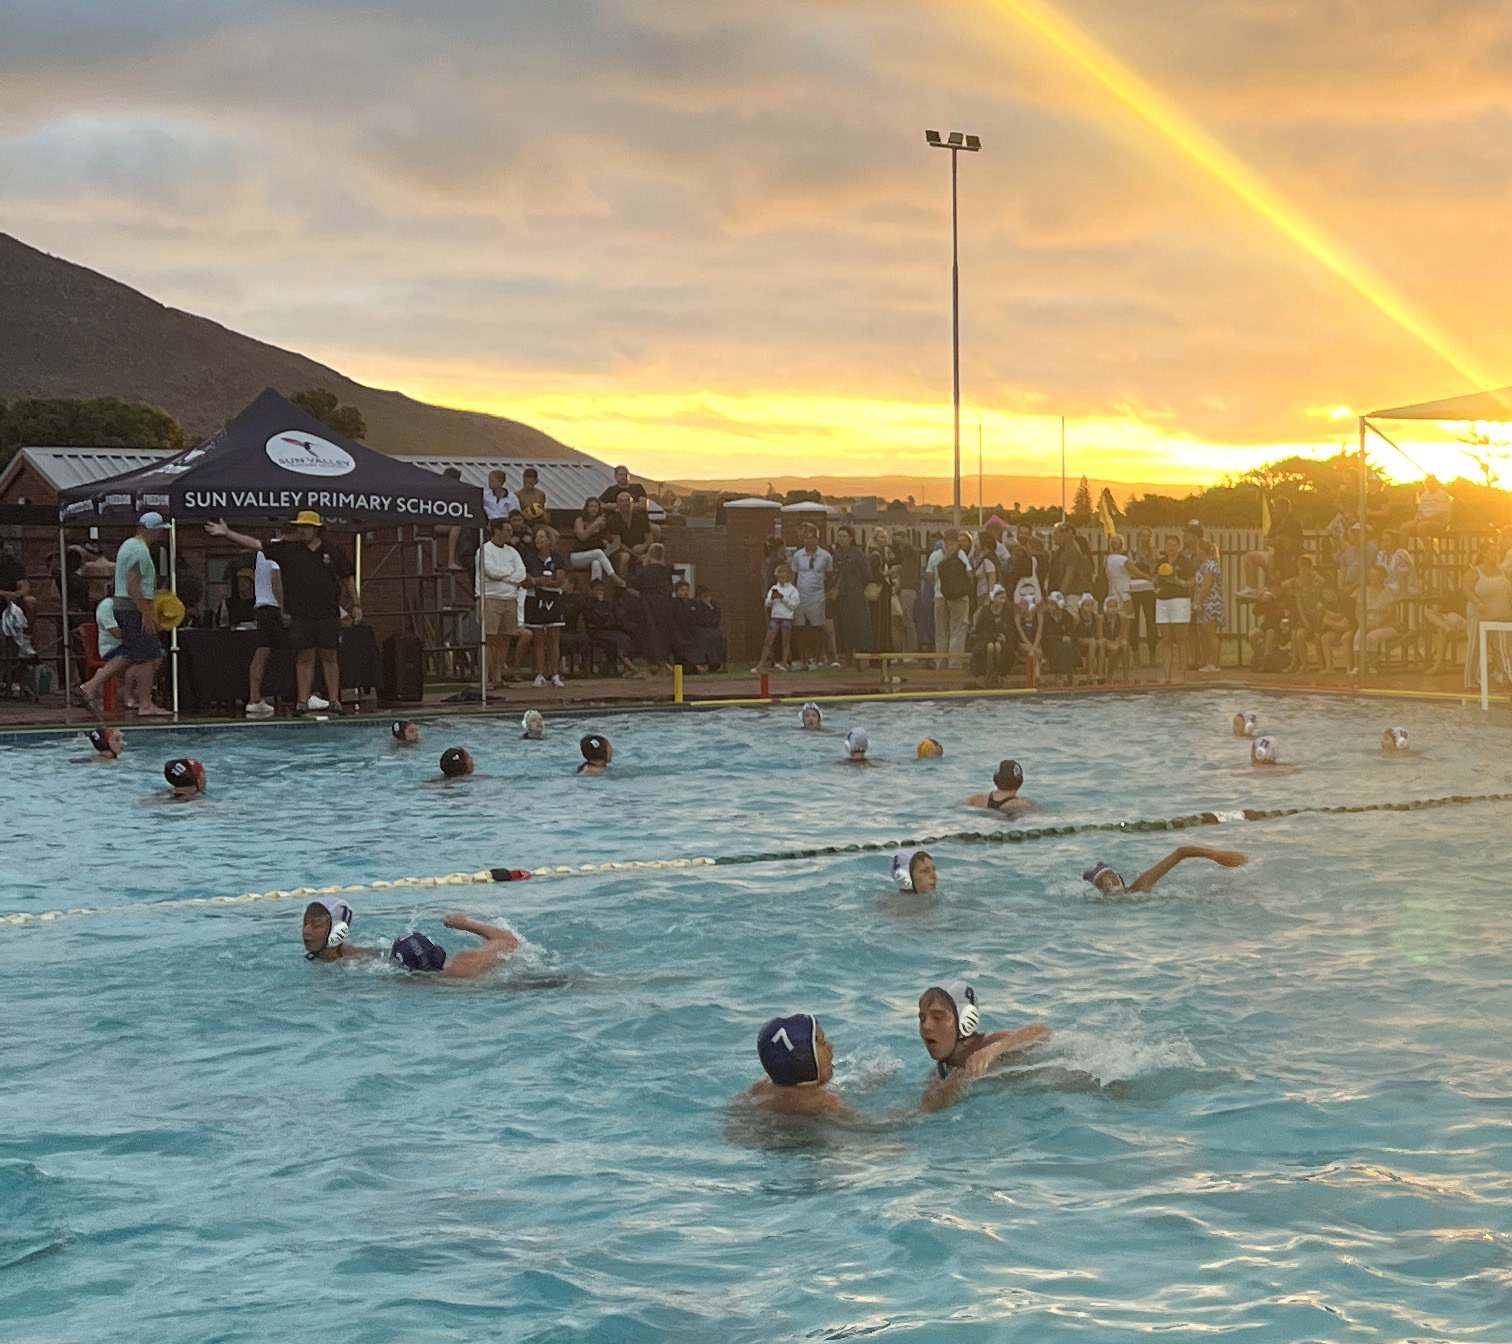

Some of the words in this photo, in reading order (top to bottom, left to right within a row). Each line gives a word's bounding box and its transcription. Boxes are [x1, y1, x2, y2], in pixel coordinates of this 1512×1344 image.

[307, 457, 350, 467] VALLEY
[185, 491, 226, 508] SUN
[231, 491, 302, 507] VALLEY
[307, 491, 393, 511] PRIMARY
[396, 497, 474, 518] SCHOOL
[170, 762, 187, 776] 10
[965, 986, 975, 1006] 9
[771, 1027, 795, 1051] 7
